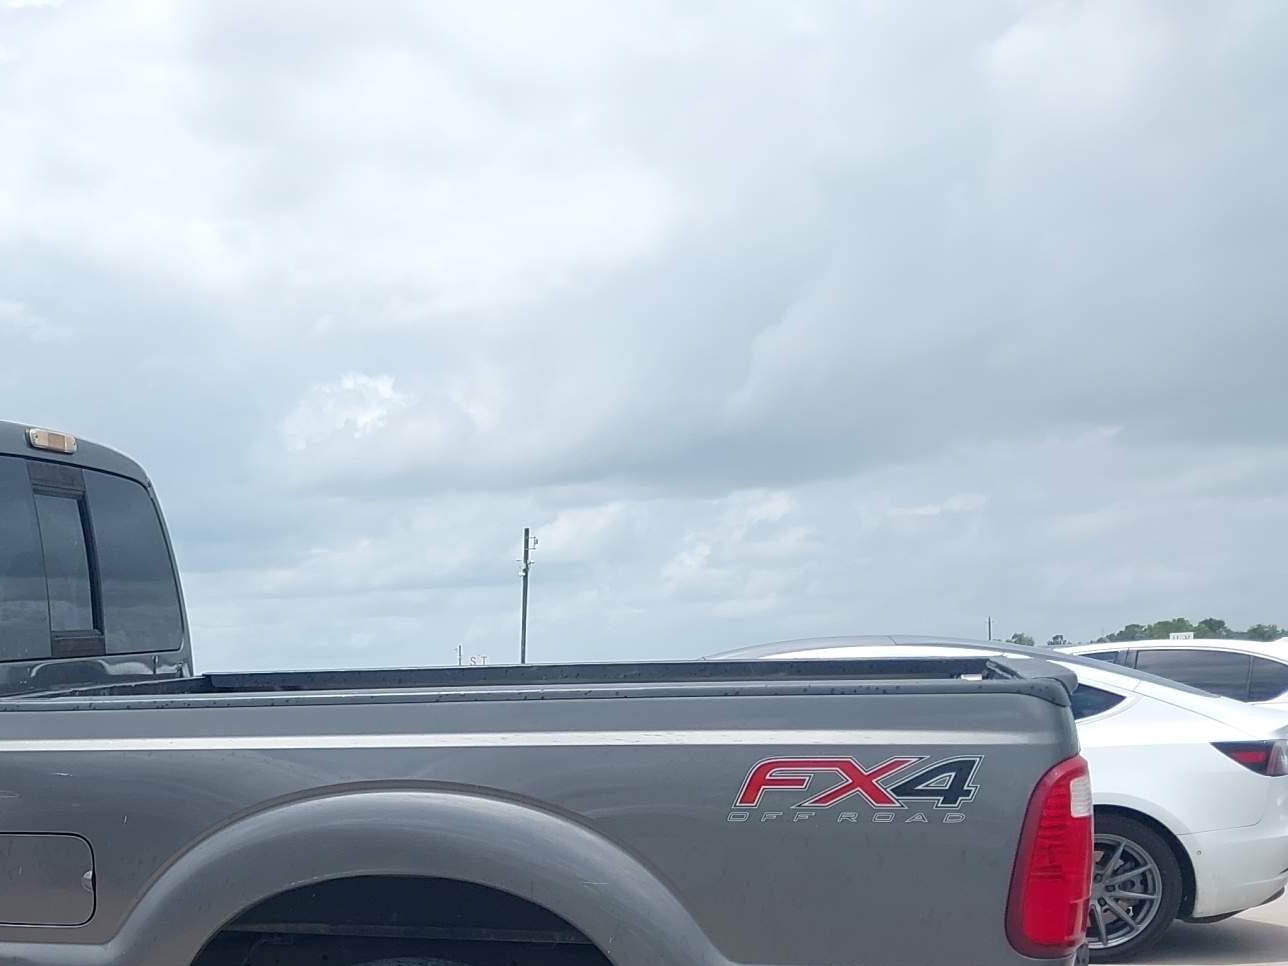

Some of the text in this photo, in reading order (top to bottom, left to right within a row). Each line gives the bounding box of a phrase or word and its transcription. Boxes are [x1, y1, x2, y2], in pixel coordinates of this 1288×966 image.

[732, 755, 984, 809] FX4
[727, 811, 967, 824] OFF ROAD
